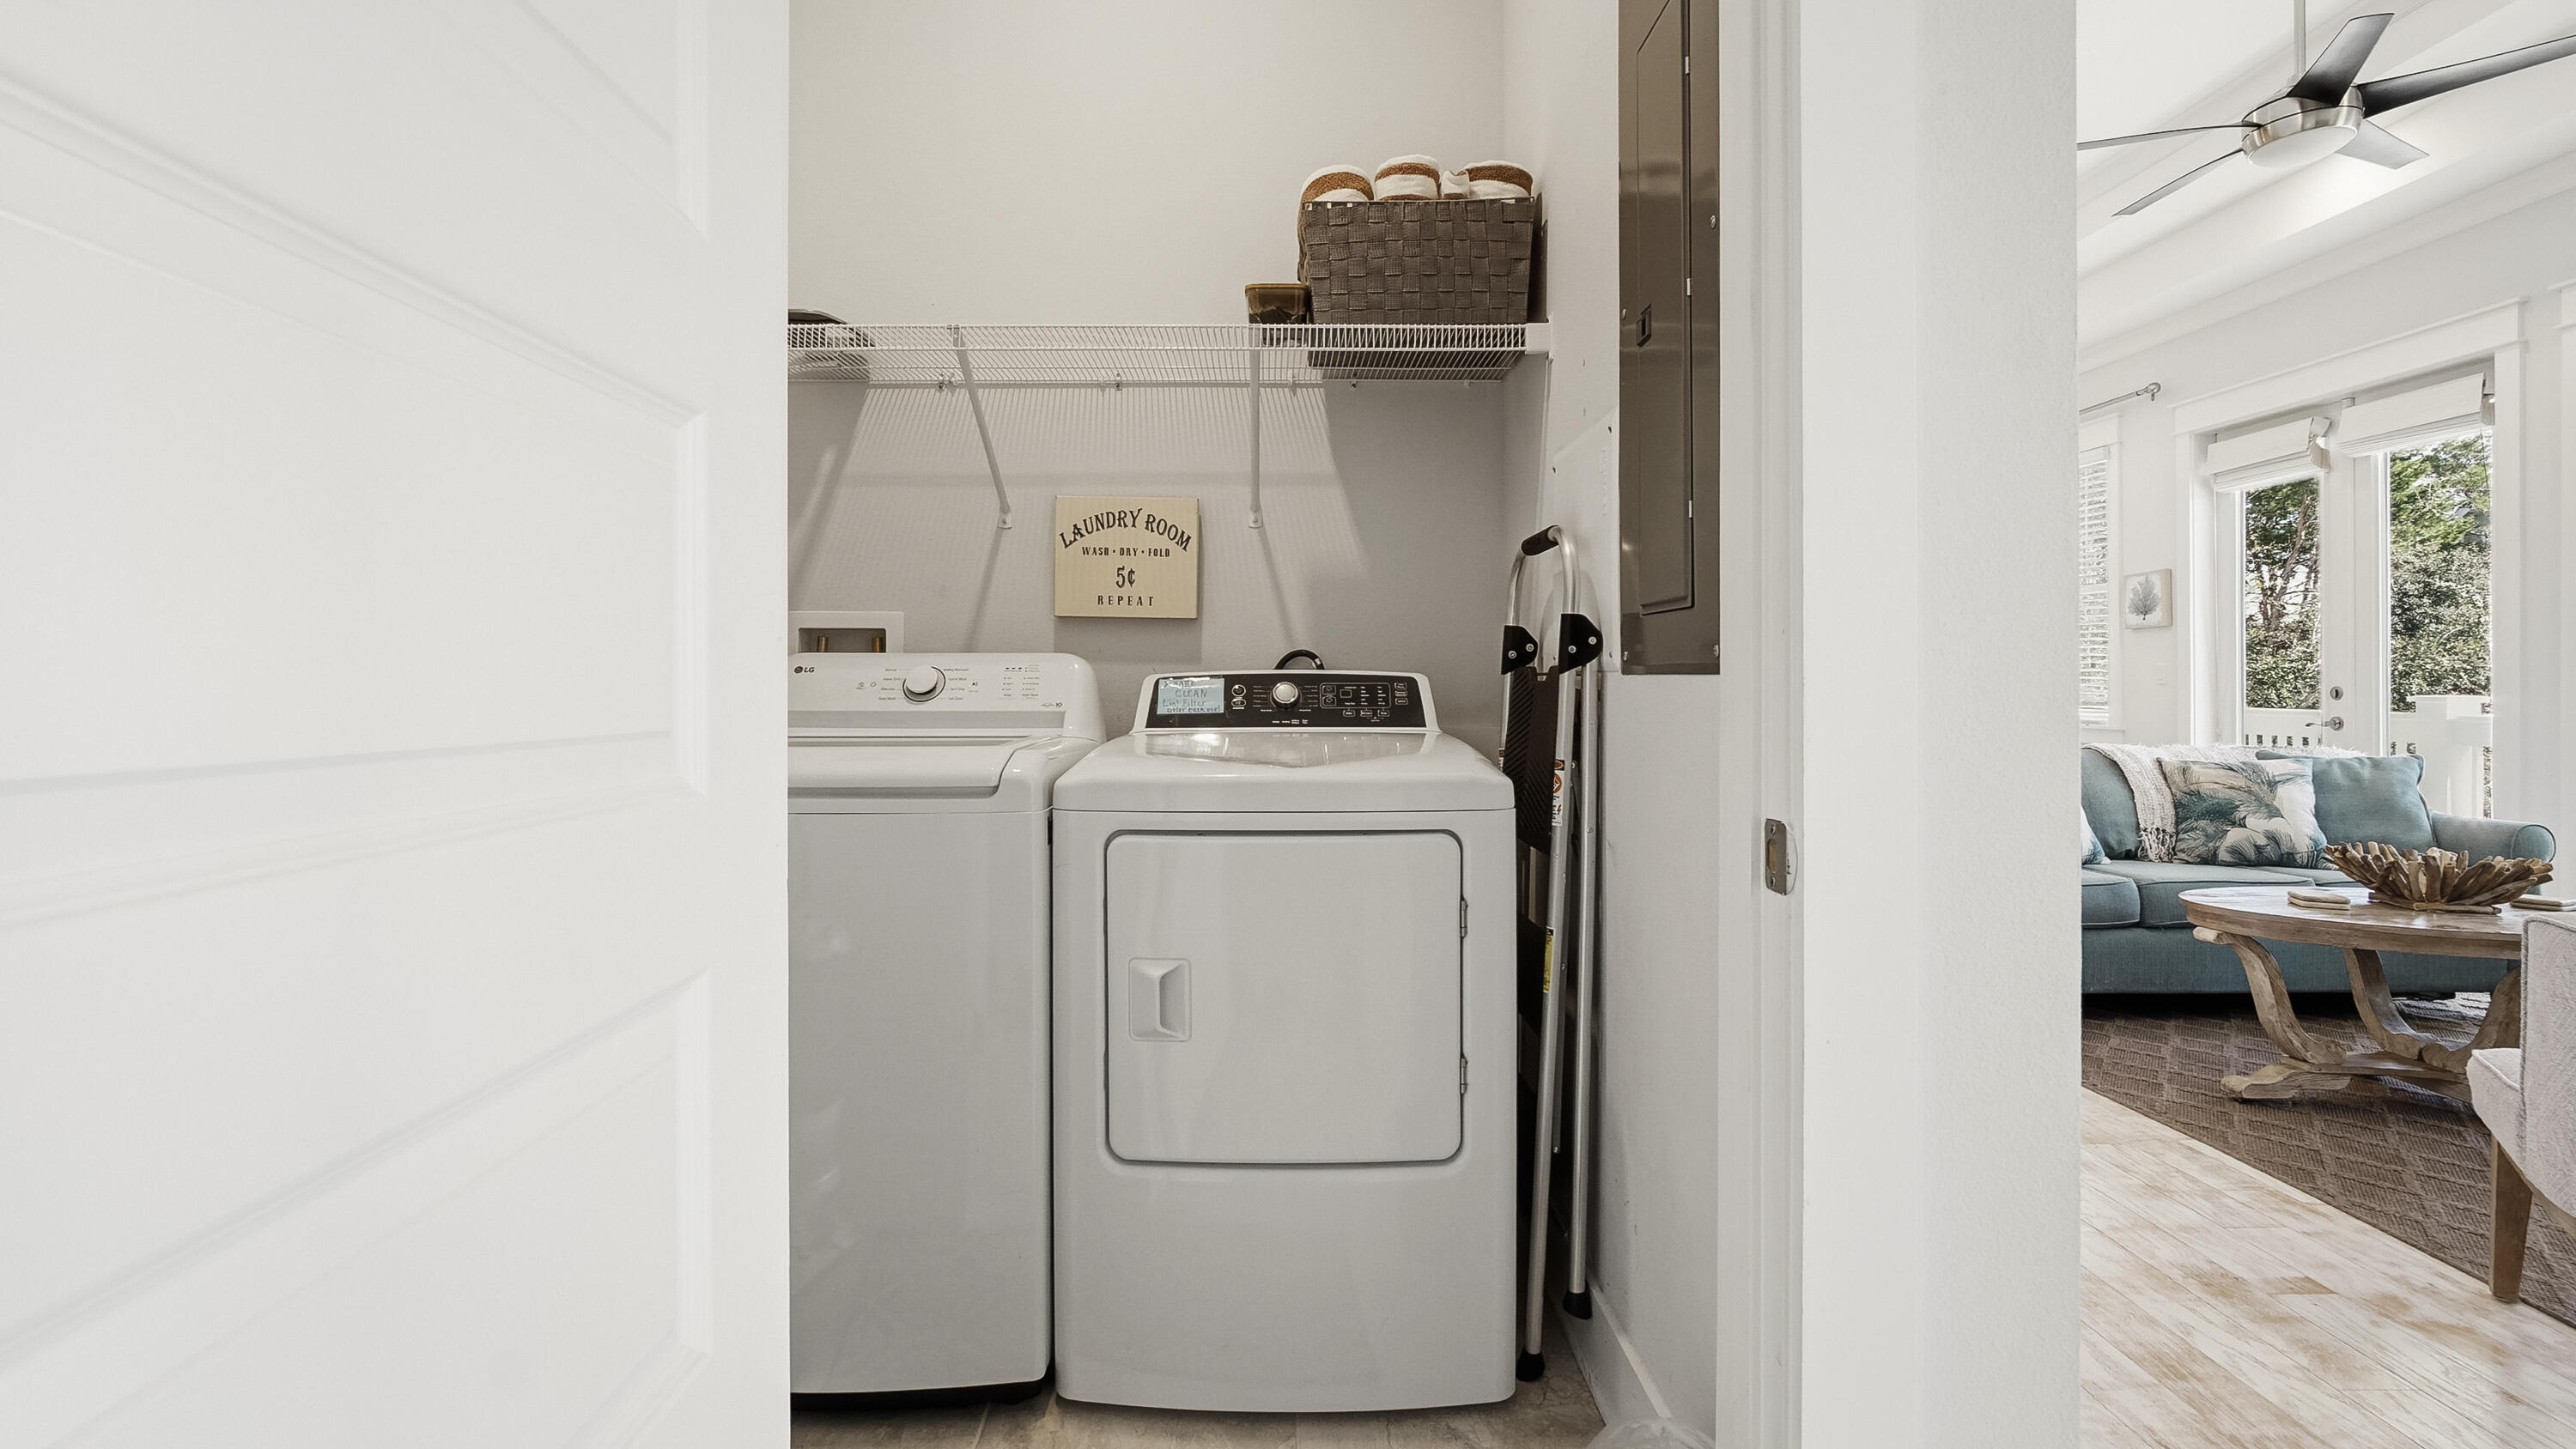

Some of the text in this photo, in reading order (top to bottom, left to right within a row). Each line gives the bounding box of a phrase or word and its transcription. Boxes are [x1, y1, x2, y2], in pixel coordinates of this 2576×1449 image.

[1059, 507, 1192, 552] LAUNDRY ROOM
[1081, 546, 1170, 557] WASH DRY FOLD
[1115, 565, 1136, 588] 5¢
[1097, 595, 1154, 606] REPEAT
[1175, 688, 1207, 698] CLEAN
